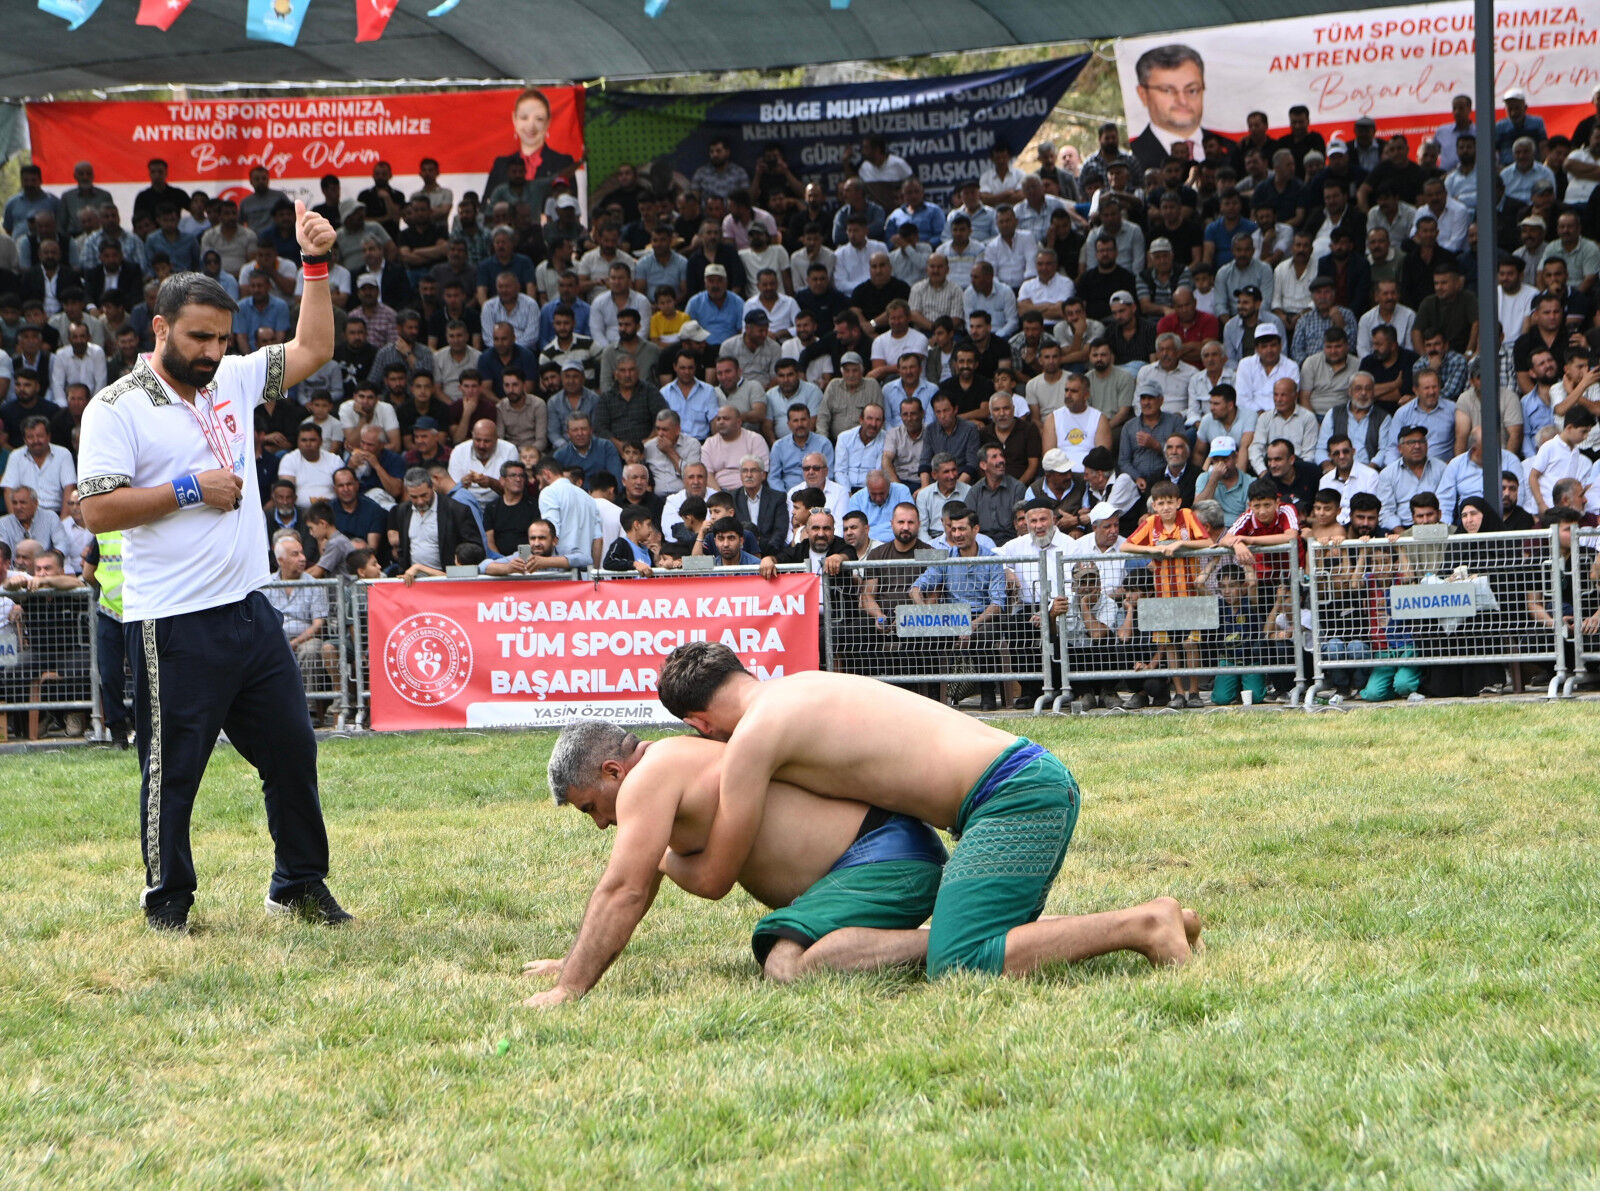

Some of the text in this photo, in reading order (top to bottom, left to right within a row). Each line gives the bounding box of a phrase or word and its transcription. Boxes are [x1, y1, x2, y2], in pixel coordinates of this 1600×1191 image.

[1314, 7, 1585, 44] TÜM SPORCULRIMIZA,
[1269, 41, 1395, 73] ANTRENÖR
[1401, 45, 1425, 59] ve
[1309, 64, 1462, 115] Başarılar
[167, 100, 391, 121] TÜM SPORCULARIMIZA,
[759, 100, 822, 122] BÖLGE
[973, 95, 1048, 122] OLDUĞU
[132, 115, 431, 142] ANTRENÖR ve İDARECİLERİMİZE
[959, 127, 996, 155] İÇİN
[302, 139, 380, 169] Dilerim
[477, 595, 806, 622] MÜSABAKALARA KATILAN
[1395, 593, 1472, 610] JANDARMA
[900, 614, 969, 627] JANDARMA
[496, 626, 565, 658] TÜM
[491, 668, 658, 700] BAŞARILAR
[534, 703, 653, 718] YASİN ÖZDEMİR
